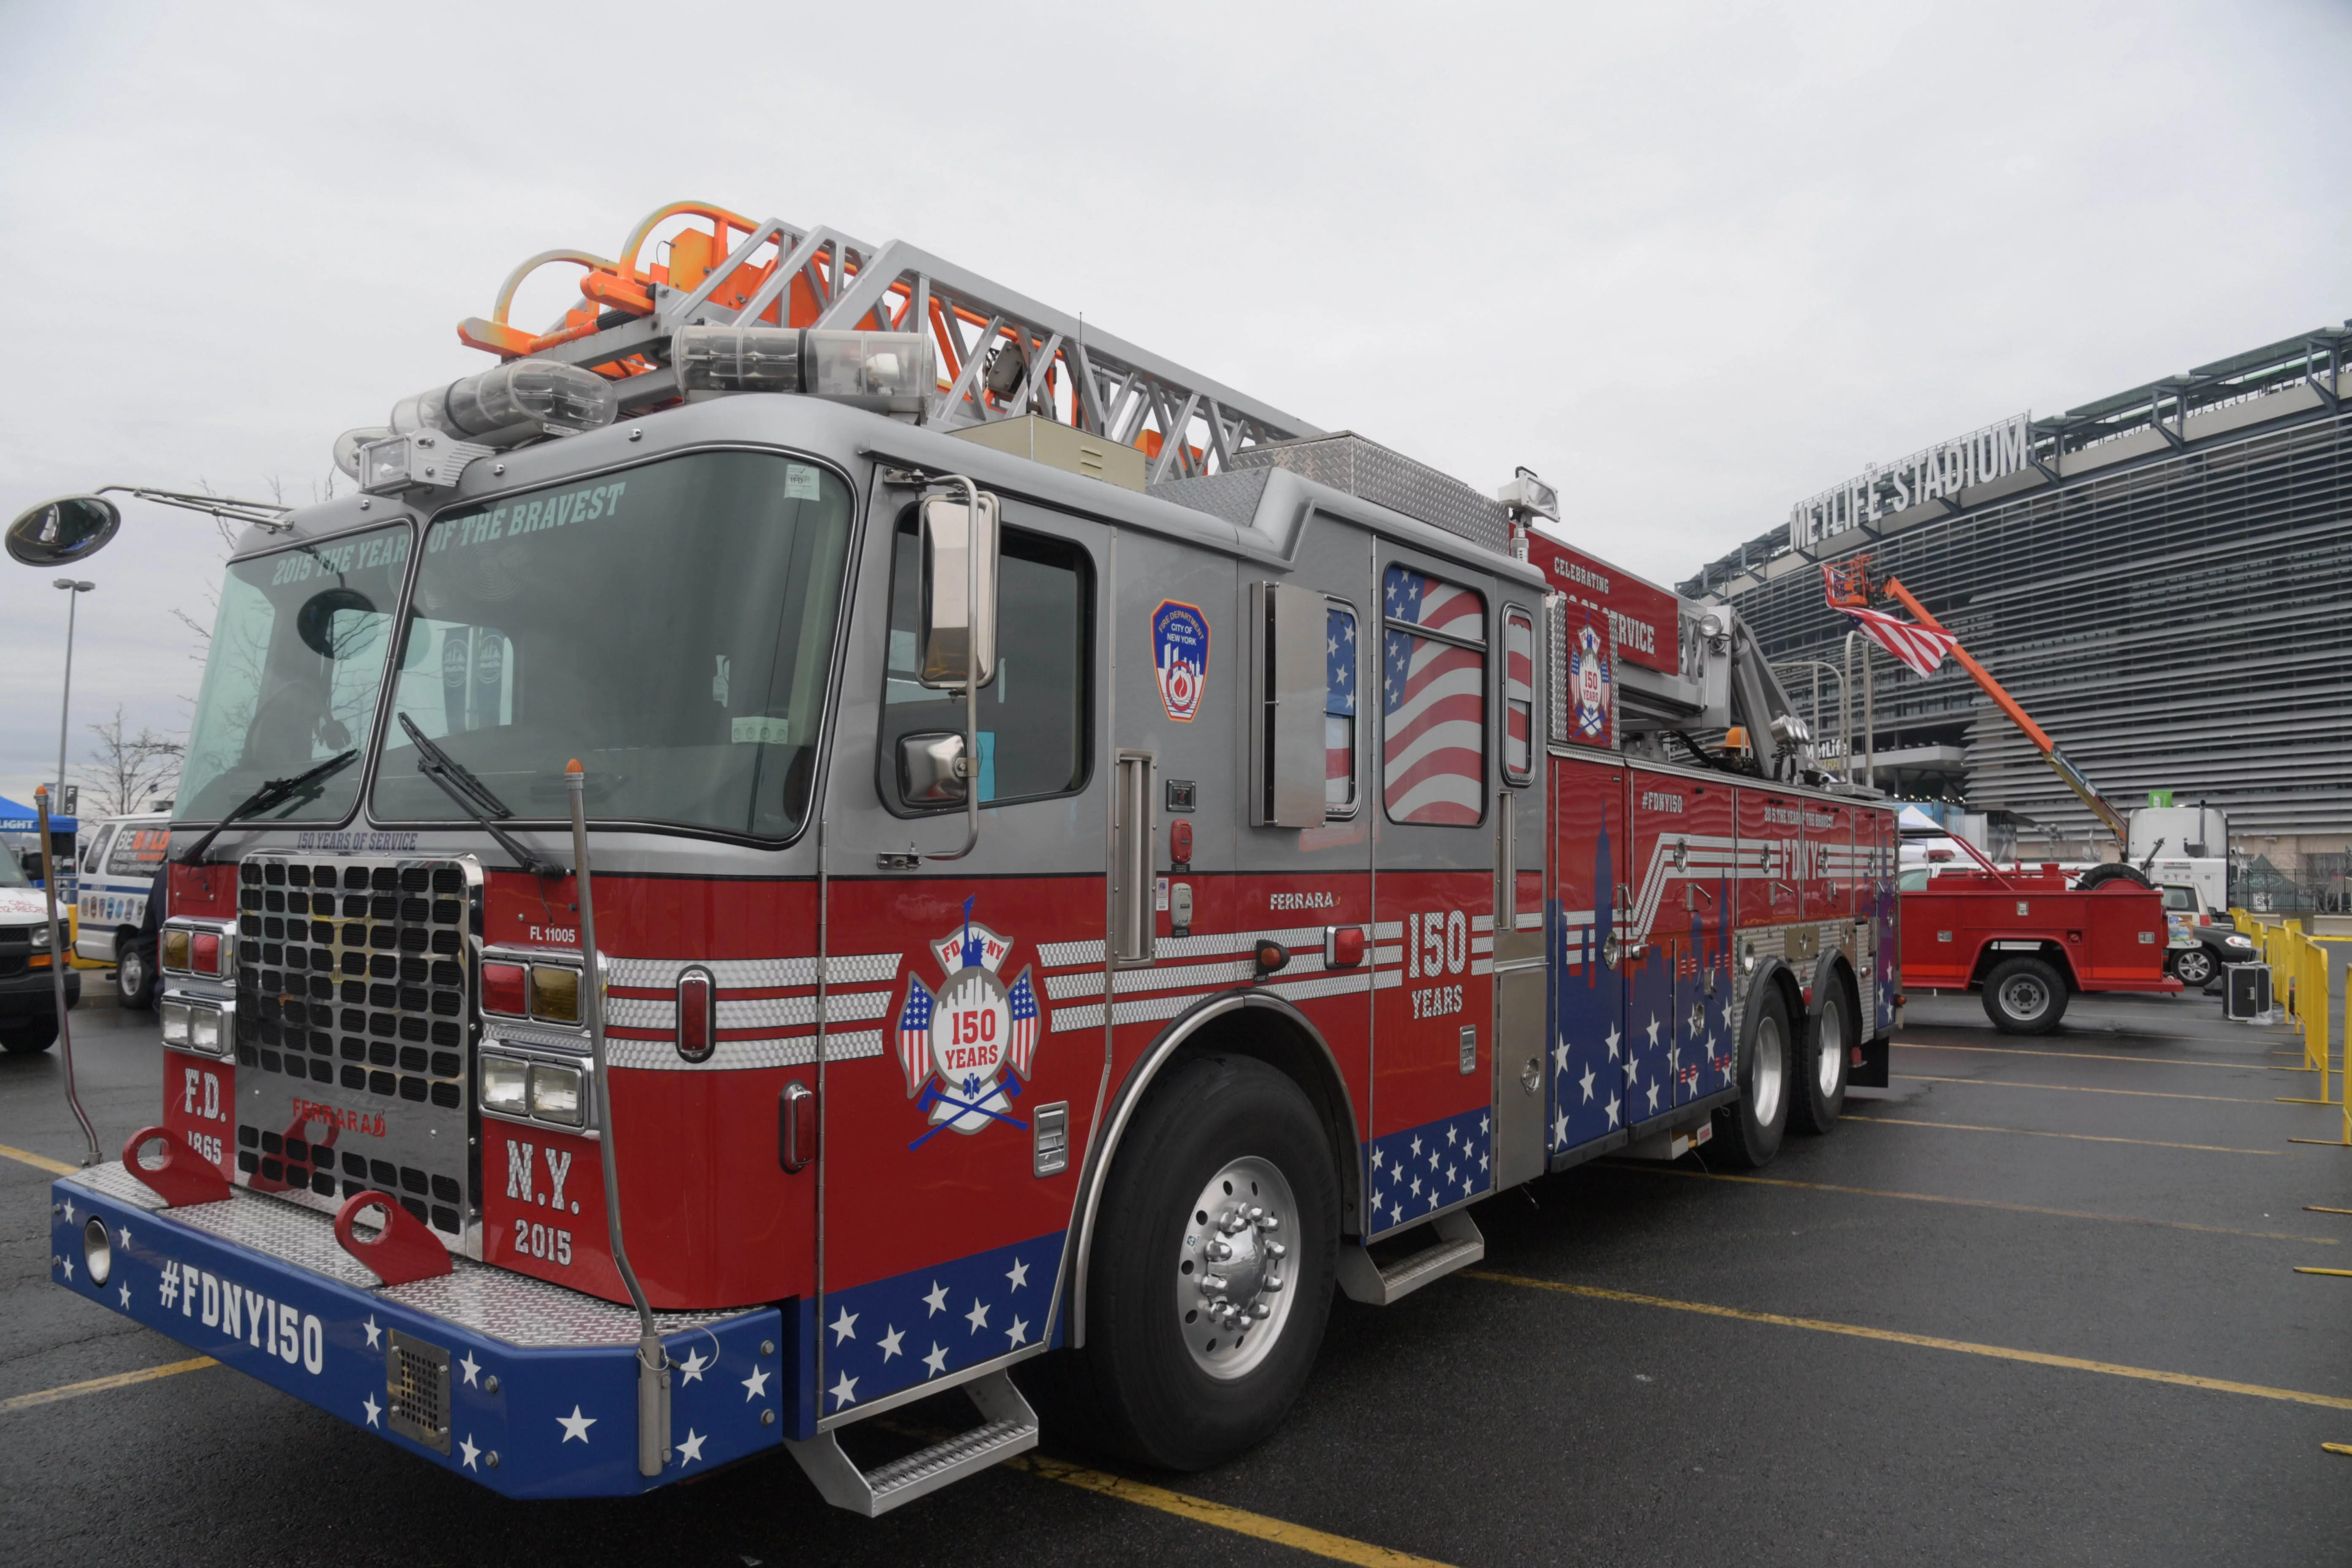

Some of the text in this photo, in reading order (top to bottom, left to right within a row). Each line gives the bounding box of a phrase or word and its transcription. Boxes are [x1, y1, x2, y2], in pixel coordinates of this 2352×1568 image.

[1790, 421, 2027, 552] METLIFE STADIUM
[272, 482, 626, 586] 2015 THE YEAR OF THE BRAVEST
[1554, 556, 1609, 594] CELEBRATING
[1158, 610, 1204, 640] FIRE DEPARTMENT
[1167, 633, 1197, 645] NEW YORK
[1171, 623, 1192, 634] CITY OF
[1603, 607, 1655, 655] RVICE
[1585, 670, 1598, 690] 150
[1583, 689, 1598, 703] YEARS
[66, 803, 74, 813] 3
[67, 788, 75, 798] F
[1642, 792, 1682, 813] #FDNY150
[1777, 808, 1786, 823] THE
[1806, 813, 1815, 827] THE
[116, 830, 137, 850] BE
[297, 832, 418, 850] 150 YEARS OF SERVICE
[1783, 838, 1818, 880] FDNY
[1270, 892, 1334, 910] FERRARA
[530, 926, 575, 942] FL 11005
[1409, 910, 1466, 978] 150
[942, 939, 1004, 963] FD NY
[1412, 984, 1462, 1019] YEARS
[952, 1009, 995, 1045] 150
[945, 1044, 998, 1070] YEARS
[184, 1067, 226, 1123] F.D.
[293, 1097, 370, 1135] FERRARA
[188, 1130, 222, 1165] 1865
[507, 1139, 580, 1215] N.Y.
[515, 1218, 571, 1266] 2015
[159, 1260, 323, 1375] #FDNY150
